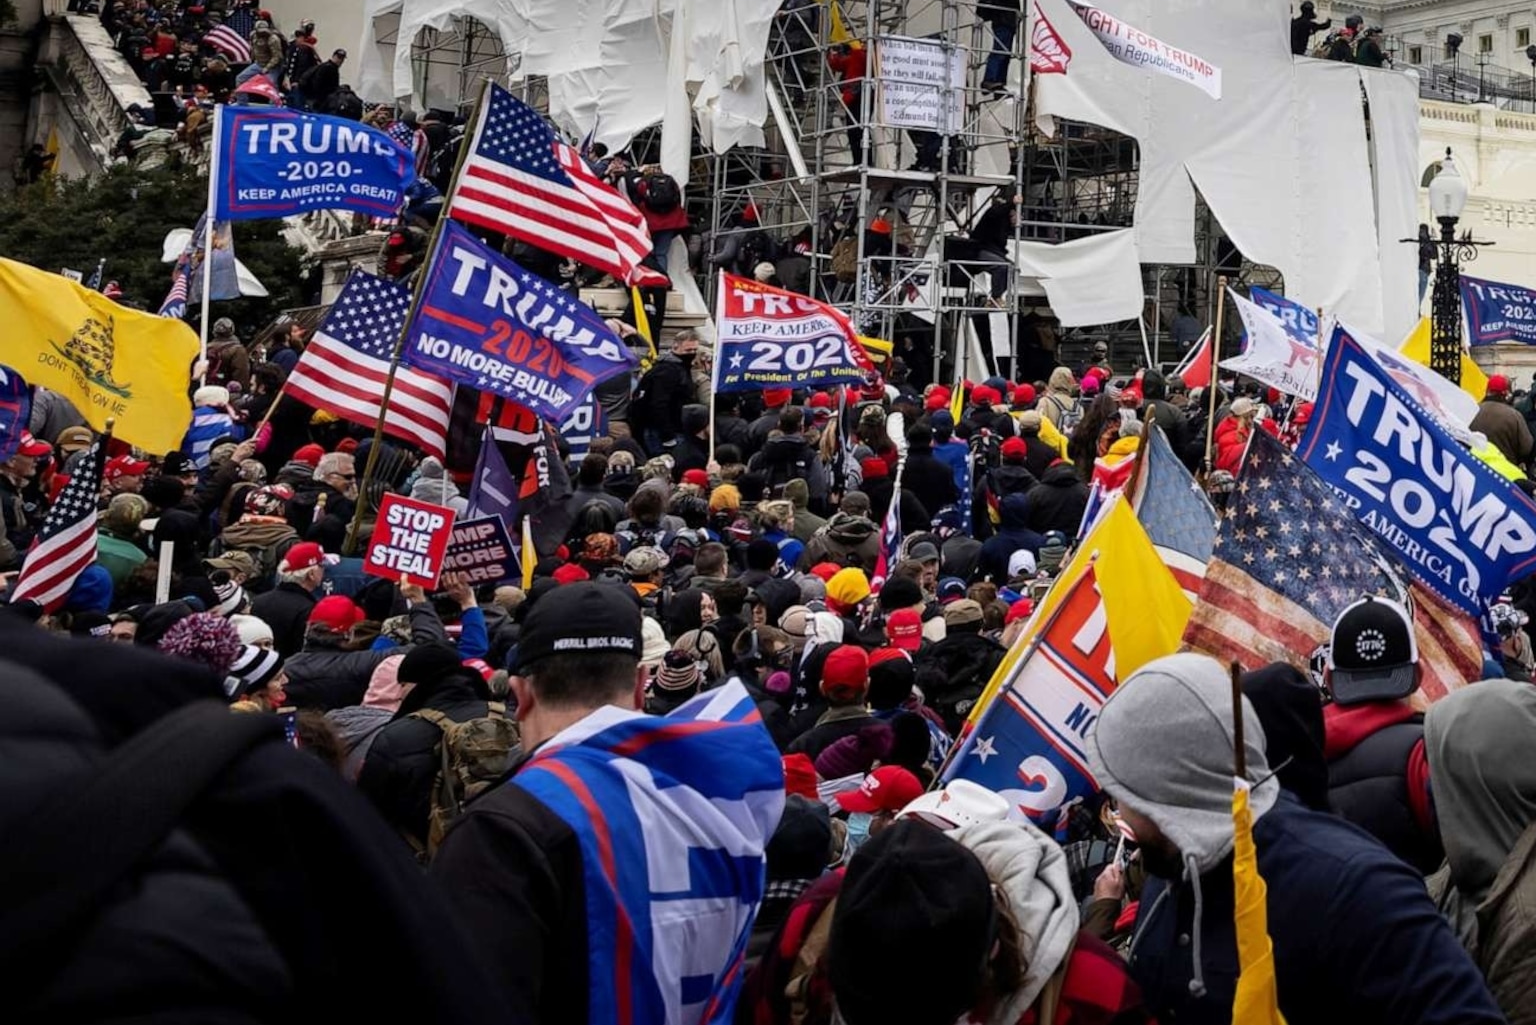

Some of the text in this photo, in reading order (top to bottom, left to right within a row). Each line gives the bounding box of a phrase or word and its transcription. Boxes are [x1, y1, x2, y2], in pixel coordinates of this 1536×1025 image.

[1125, 44, 1195, 81] Republicans
[1127, 29, 1159, 52] FOR
[1164, 47, 1214, 78] TRUMP
[238, 183, 398, 202] KEEP AMERICA GREAT!
[732, 323, 772, 336] KEEP
[1480, 321, 1504, 333] KEEP
[417, 333, 451, 359] NO
[450, 343, 514, 383] MORE
[38, 352, 69, 372] DONT
[93, 392, 109, 409] ON
[386, 503, 445, 530] STOP
[390, 526, 431, 554] THE
[1362, 511, 1454, 582] AMERICA
[371, 545, 435, 580] STEAL
[1361, 640, 1381, 651] 1776
